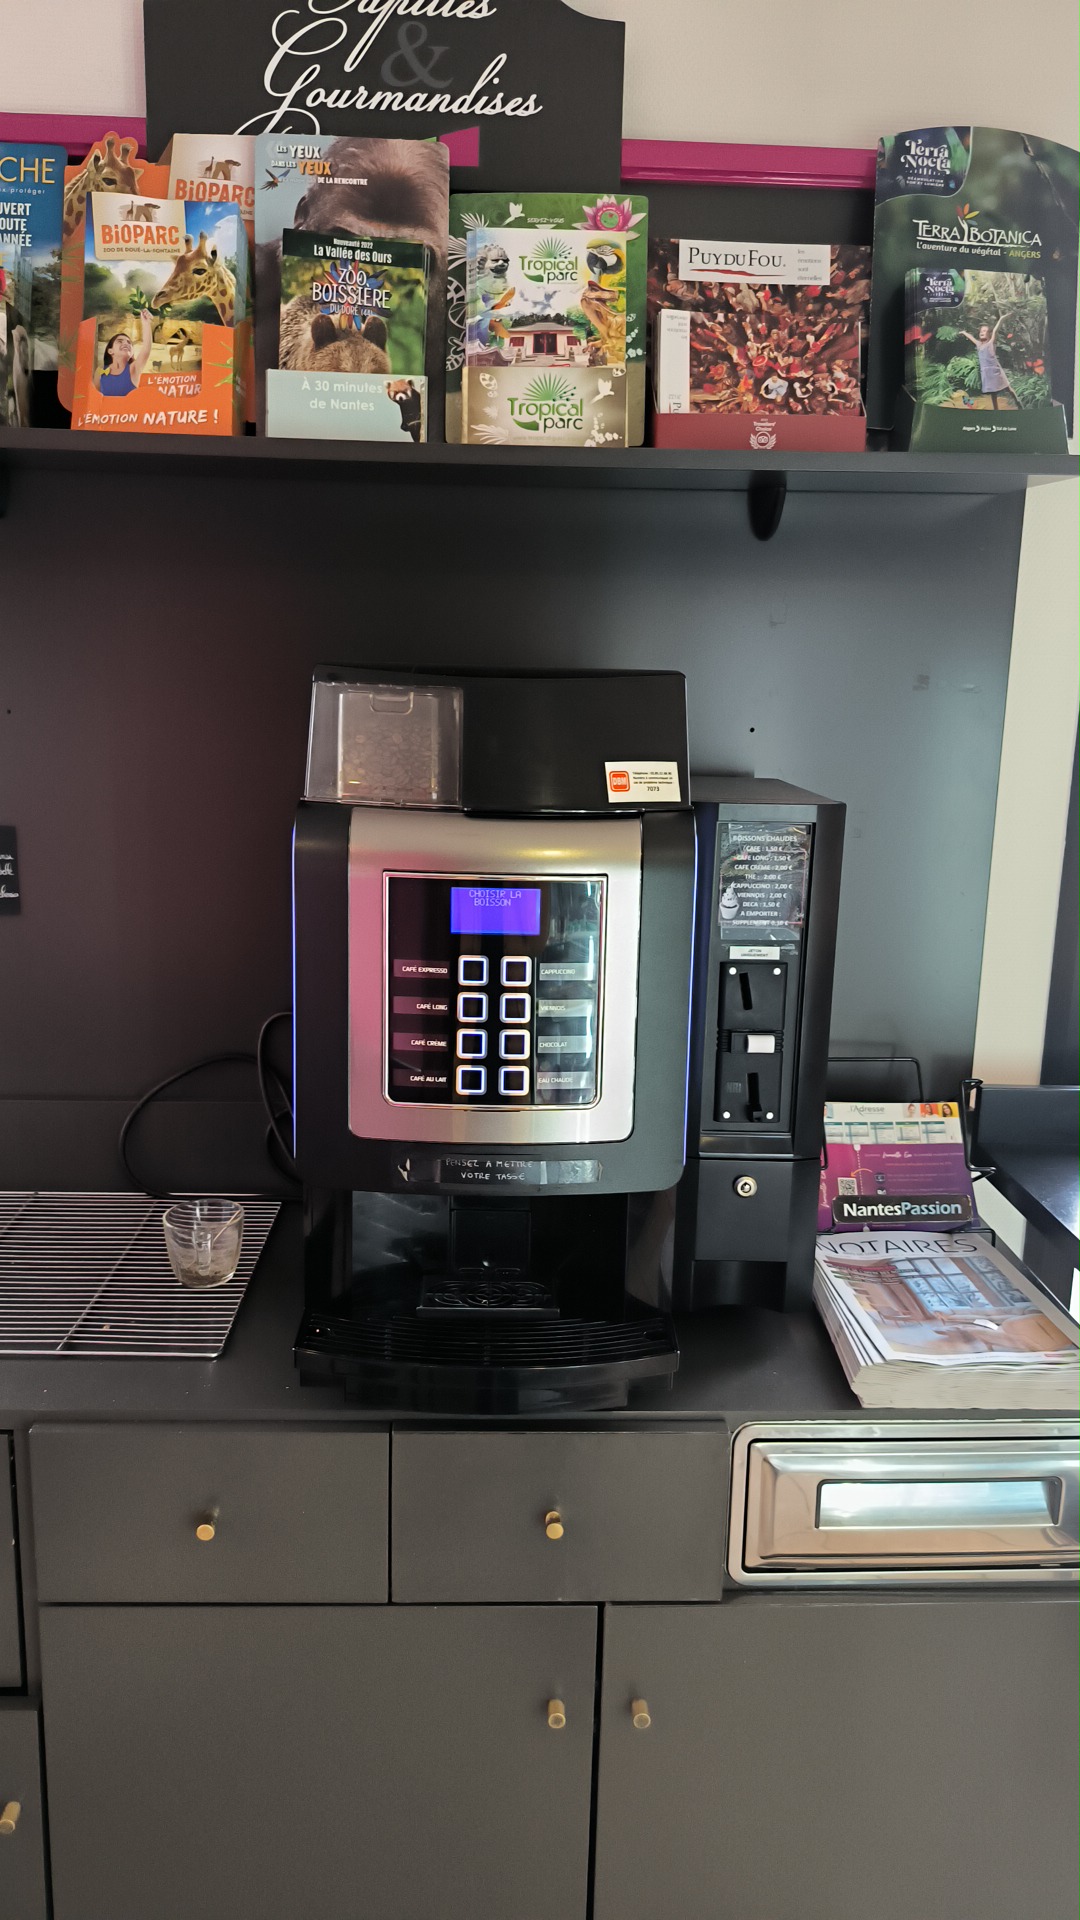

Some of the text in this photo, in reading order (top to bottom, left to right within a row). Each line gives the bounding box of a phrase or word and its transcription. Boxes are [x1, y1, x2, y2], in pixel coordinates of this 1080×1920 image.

[380, 21, 454, 89] &
[264, 10, 543, 134] Gourmandises
[289, 145, 321, 159] YEUX
[905, 139, 949, 158] Terra
[298, 161, 332, 176] YEUX
[900, 155, 952, 175] Nocta
[334, 178, 368, 186] RENCONTRE
[912, 219, 1042, 246] TERRA BOTANICA
[313, 244, 392, 264] La Vallée des Ours
[916, 241, 957, 253] L'aventure
[959, 246, 970, 254] du
[971, 247, 1001, 257] végétal
[1009, 251, 1041, 259] ANGERS
[519, 256, 578, 275] Tropical
[338, 268, 367, 286] ZOO
[547, 271, 578, 285] parc
[312, 281, 391, 309] BOISSIÈRE
[330, 305, 340, 313] DU
[342, 304, 359, 316] DORÉ
[301, 376, 383, 393] À 30 minutes
[309, 398, 375, 411] de Nantes
[507, 398, 583, 421] Tropical
[78, 409, 219, 427] L'ÉMOTION NATURE !
[543, 417, 583, 434] parc
[469, 890, 522, 899] CHOISIR LA
[474, 898, 512, 906] BOISSON
[402, 965, 418, 973] CAFÉ
[426, 1039, 447, 1047] CRÈME
[445, 1158, 479, 1168] PENSEZ
[496, 1159, 533, 1168] METTRE
[461, 1172, 490, 1180] VOTRE
[843, 1201, 962, 1217] NantesPassion
[816, 1238, 978, 1255] NOTAIRES
